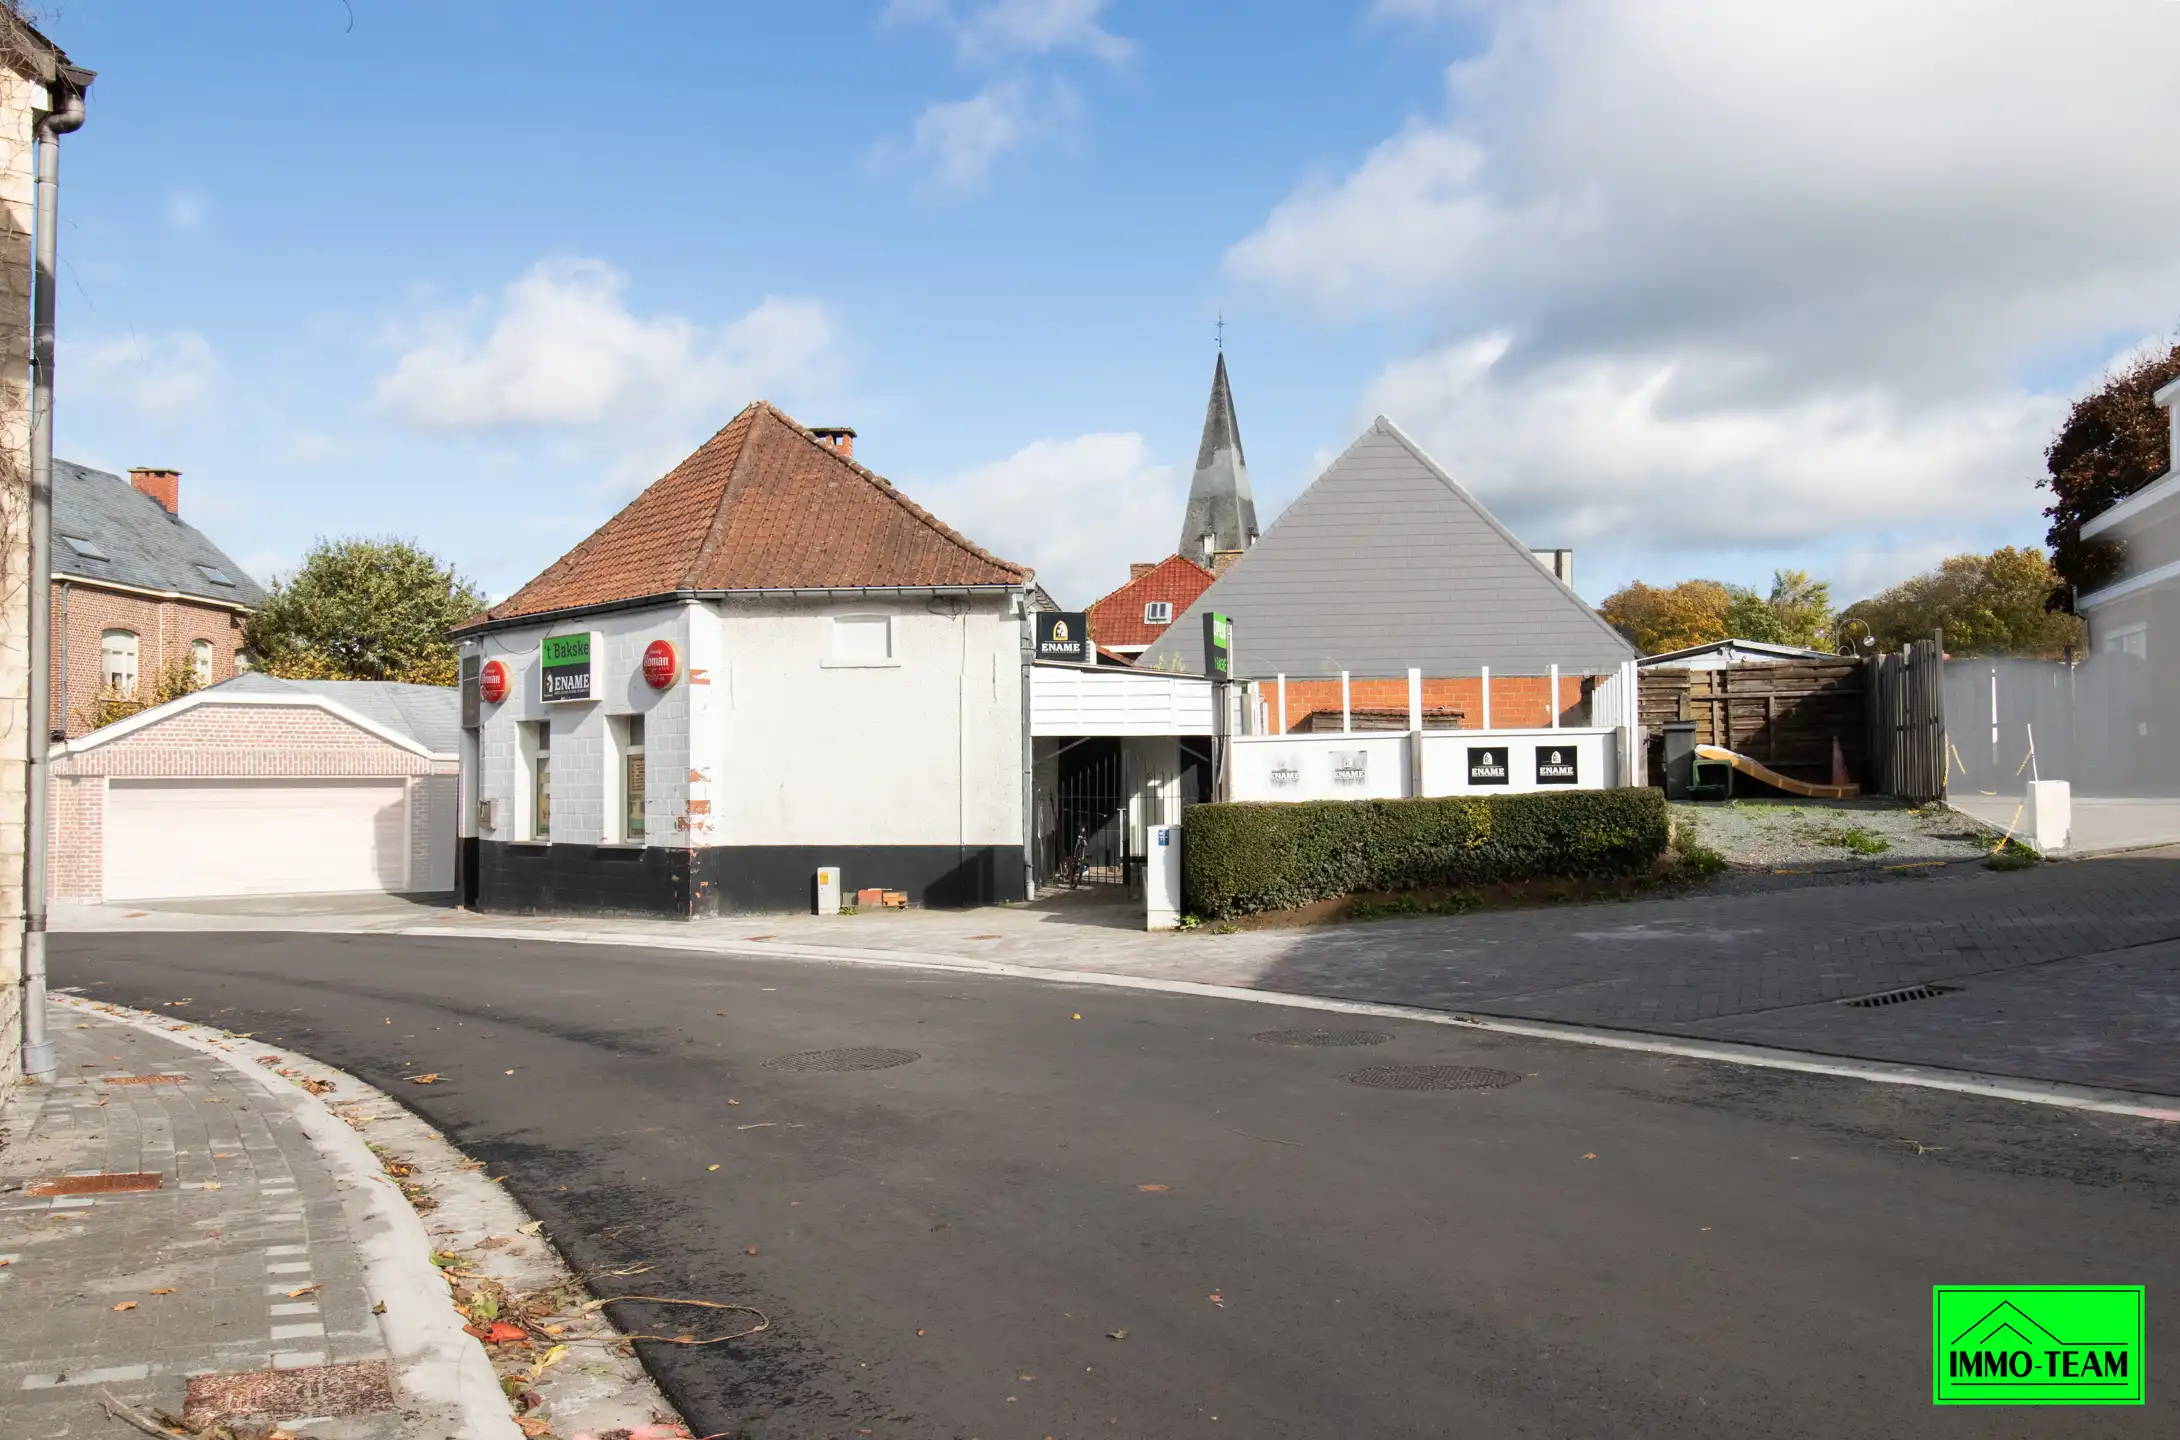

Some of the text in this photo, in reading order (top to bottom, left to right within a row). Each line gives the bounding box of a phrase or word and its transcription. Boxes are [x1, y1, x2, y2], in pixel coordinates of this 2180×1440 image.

[553, 640, 589, 659] Bakske
[1041, 643, 1081, 652] ENAME
[554, 673, 589, 690] ENAME
[1333, 770, 1365, 779] ENAME
[1472, 767, 1505, 775] ENAME
[1540, 766, 1574, 775] ENAME
